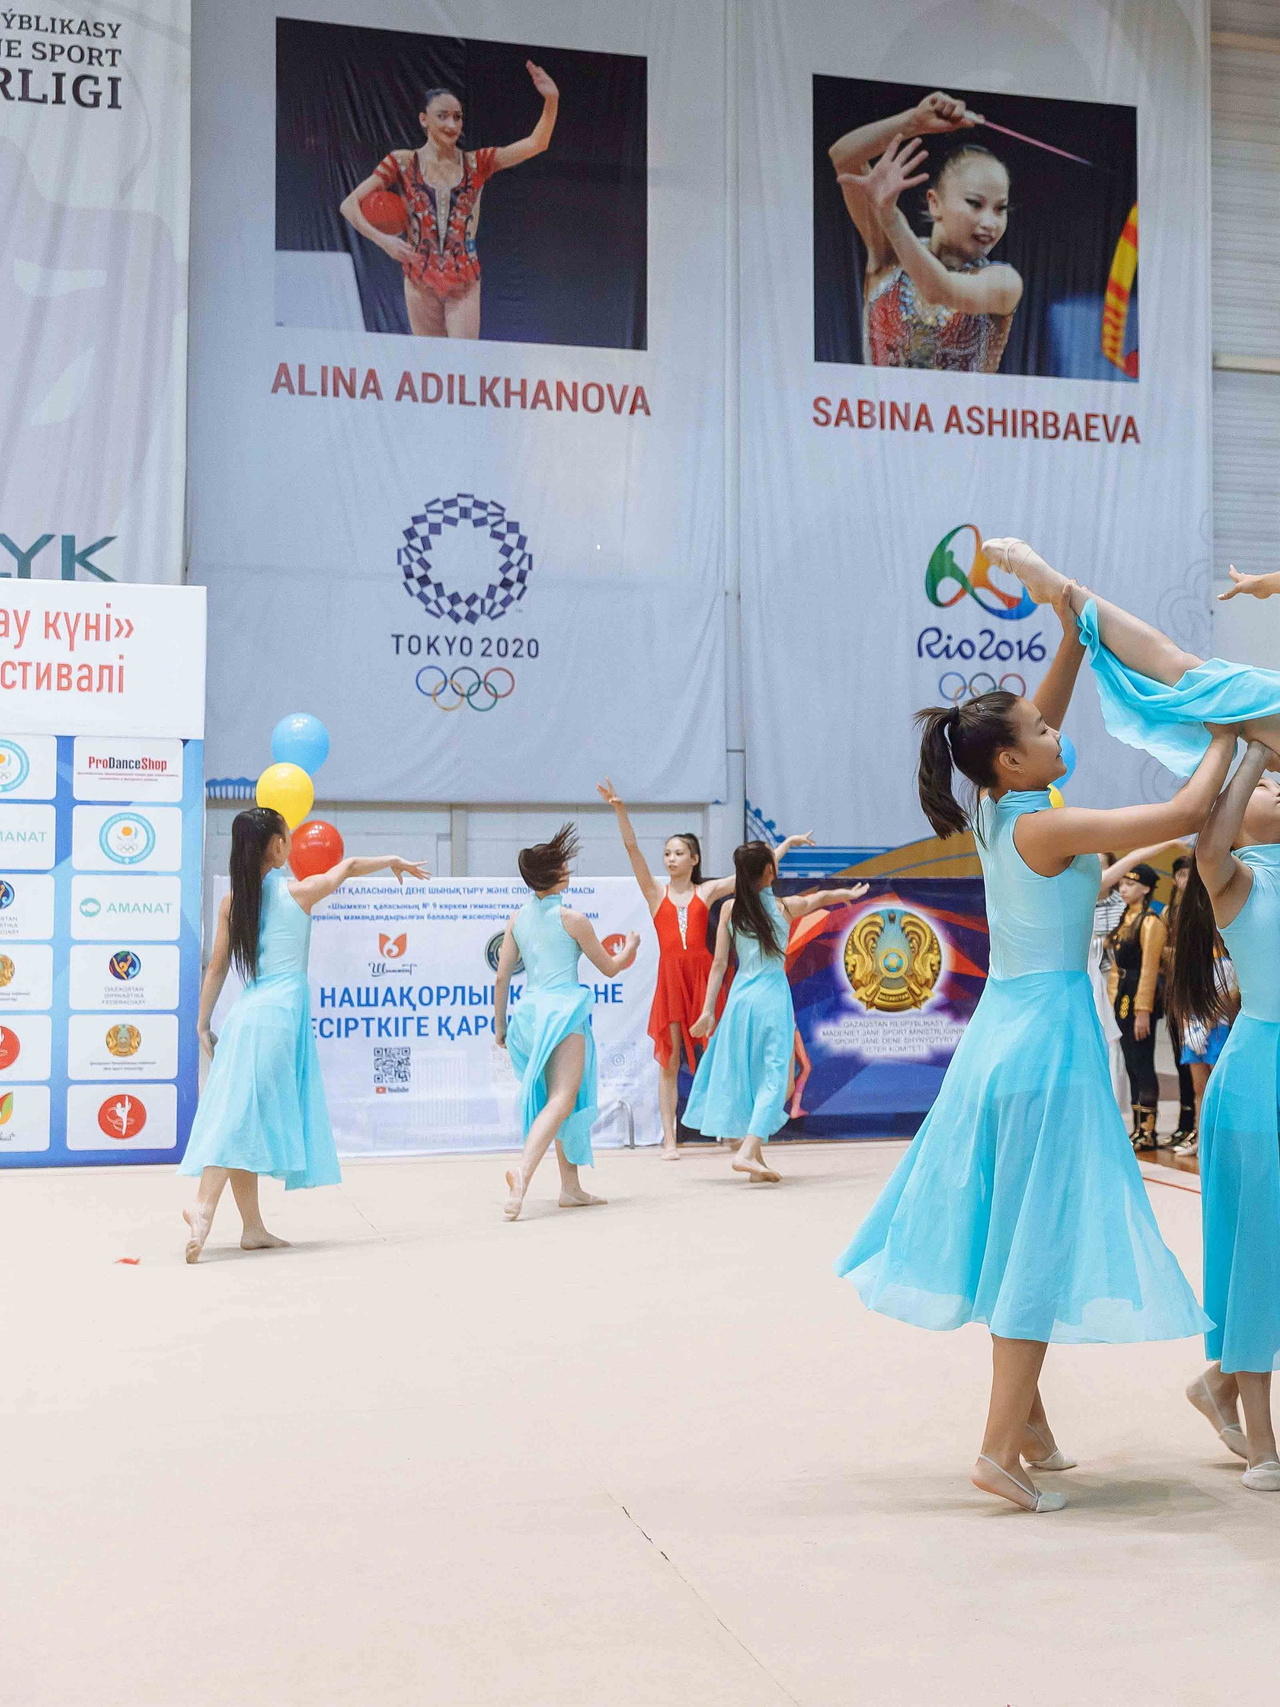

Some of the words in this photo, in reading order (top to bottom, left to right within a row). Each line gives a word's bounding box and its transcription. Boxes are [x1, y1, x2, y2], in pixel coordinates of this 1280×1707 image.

[0, 38, 22, 58] E
[32, 41, 122, 67] SPORT
[270, 362, 383, 402] ALINA
[394, 370, 652, 417] ADILKHANOVA
[812, 396, 934, 433] SABINA
[944, 404, 1141, 444] ASHIRBAEVA
[0, 533, 119, 582] YK
[391, 634, 473, 657] TOKYO
[481, 637, 540, 659] 2020
[0, 654, 124, 693] стивалі
[88, 756, 167, 772] ProDanceShop
[0, 831, 47, 843] ANAT
[405, 887, 425, 896] ДЕНЕ
[106, 902, 173, 914] AMANAT
